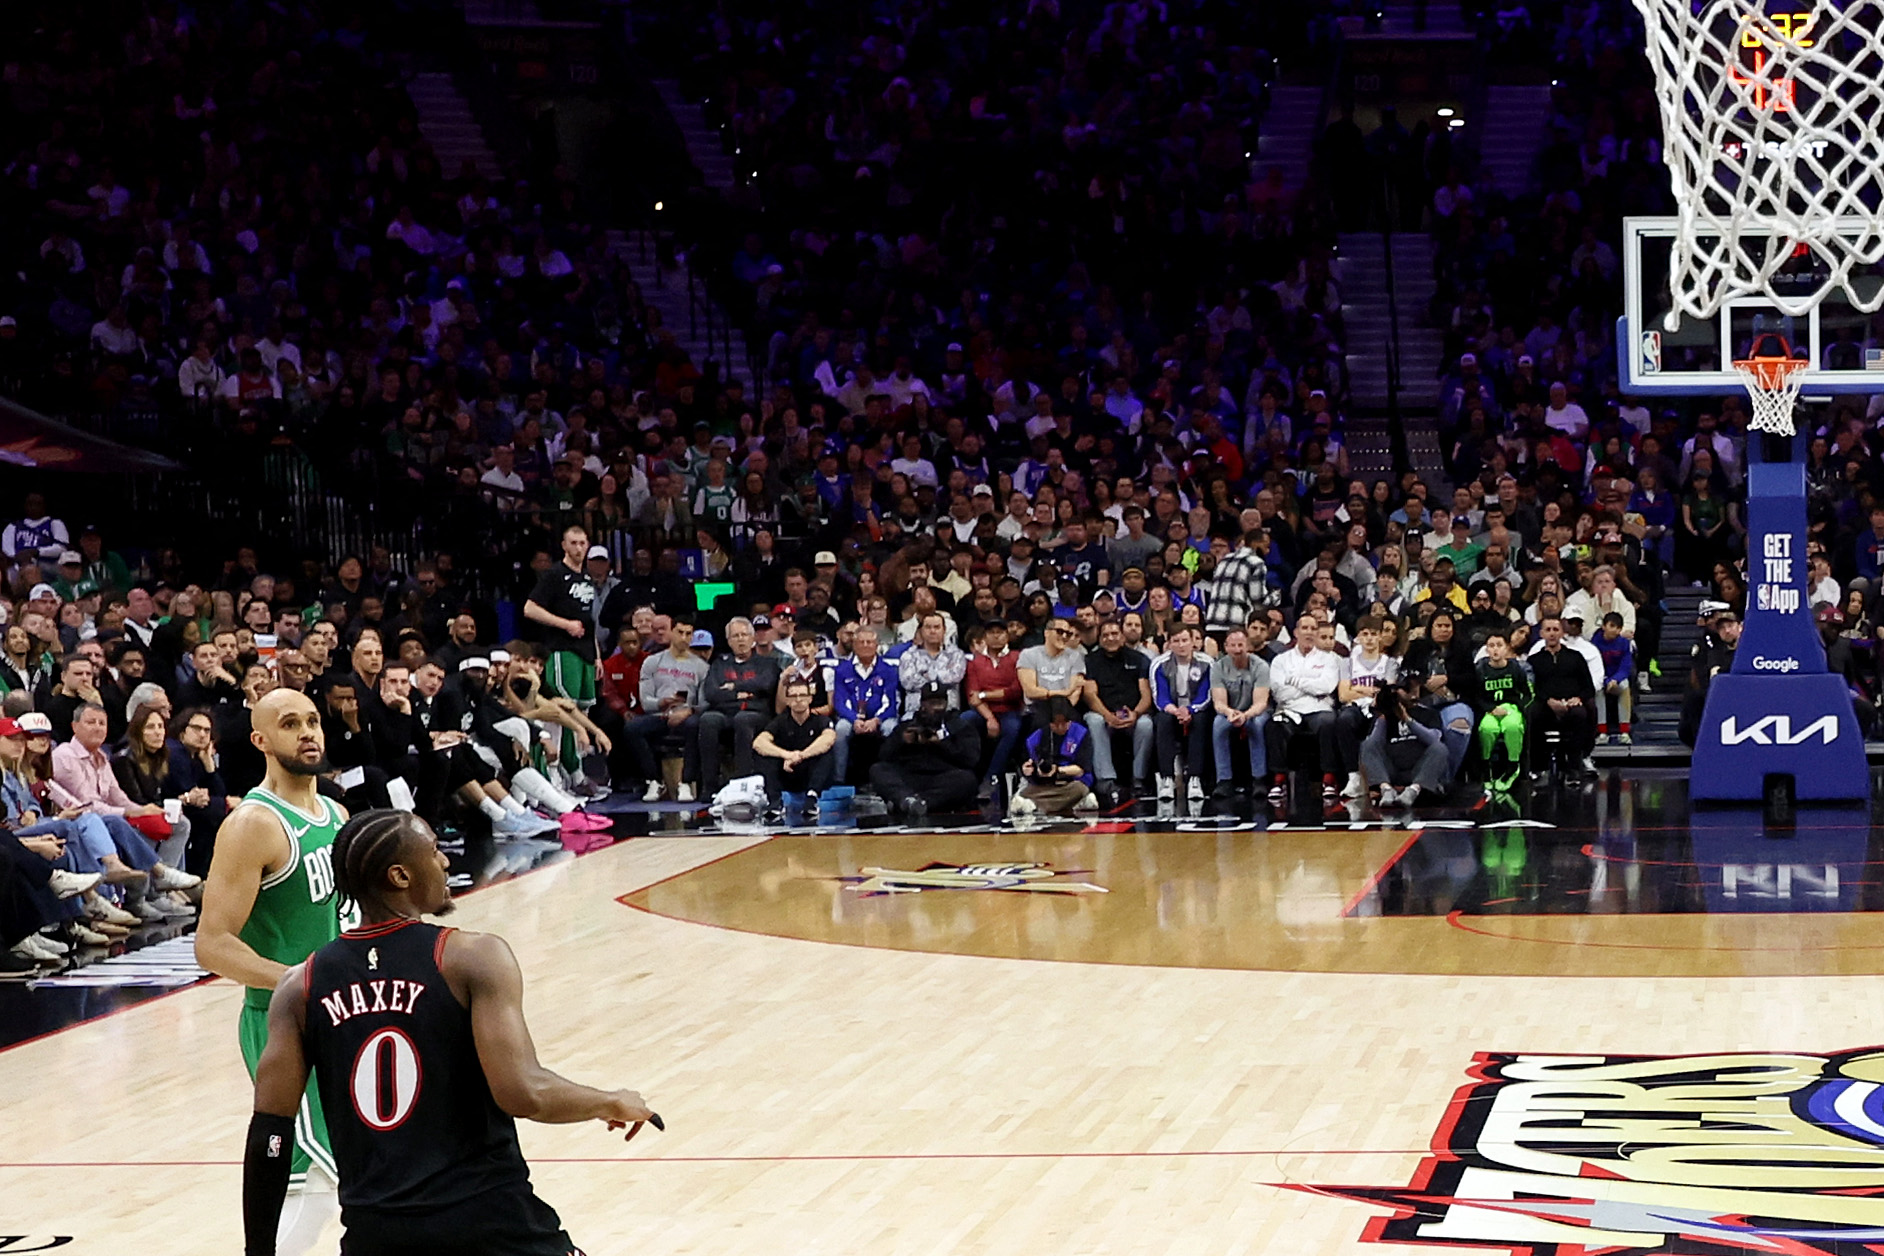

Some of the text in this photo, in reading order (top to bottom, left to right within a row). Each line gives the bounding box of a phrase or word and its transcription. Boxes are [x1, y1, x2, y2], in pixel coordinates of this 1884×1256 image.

[1763, 533, 1792, 558] GET
[1763, 559, 1793, 583] THE
[1770, 584, 1799, 614] App
[1752, 656, 1800, 674] Google
[1484, 677, 1513, 691] CELTICS
[1720, 715, 1839, 745] KIA
[1176, 820, 1558, 832] ULTRA
[320, 980, 427, 1028] MAXEY
[348, 1026, 423, 1131] 0
